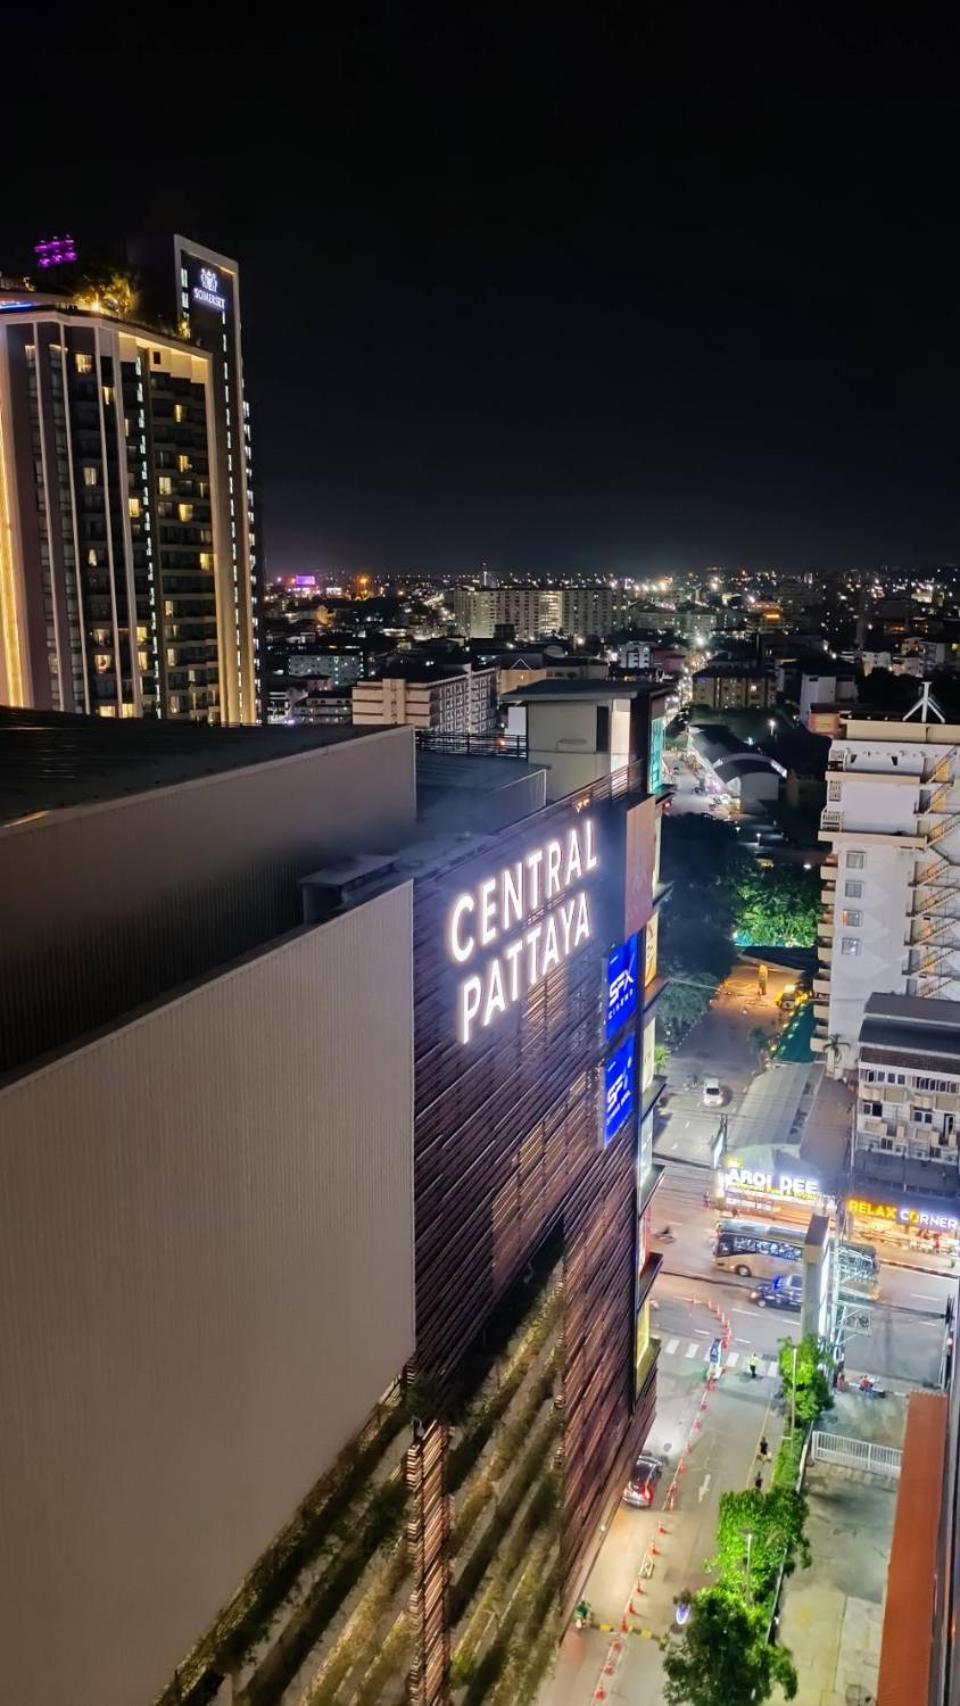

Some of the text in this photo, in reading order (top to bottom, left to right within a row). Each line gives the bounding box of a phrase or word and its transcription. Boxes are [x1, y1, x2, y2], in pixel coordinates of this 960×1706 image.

[450, 820, 598, 962] CENTRAL
[462, 892, 591, 1045] PATTAYA
[727, 1168, 773, 1189] AROI
[780, 1175, 819, 1194] DEE
[848, 1200, 958, 1230] RELAX CORNER
